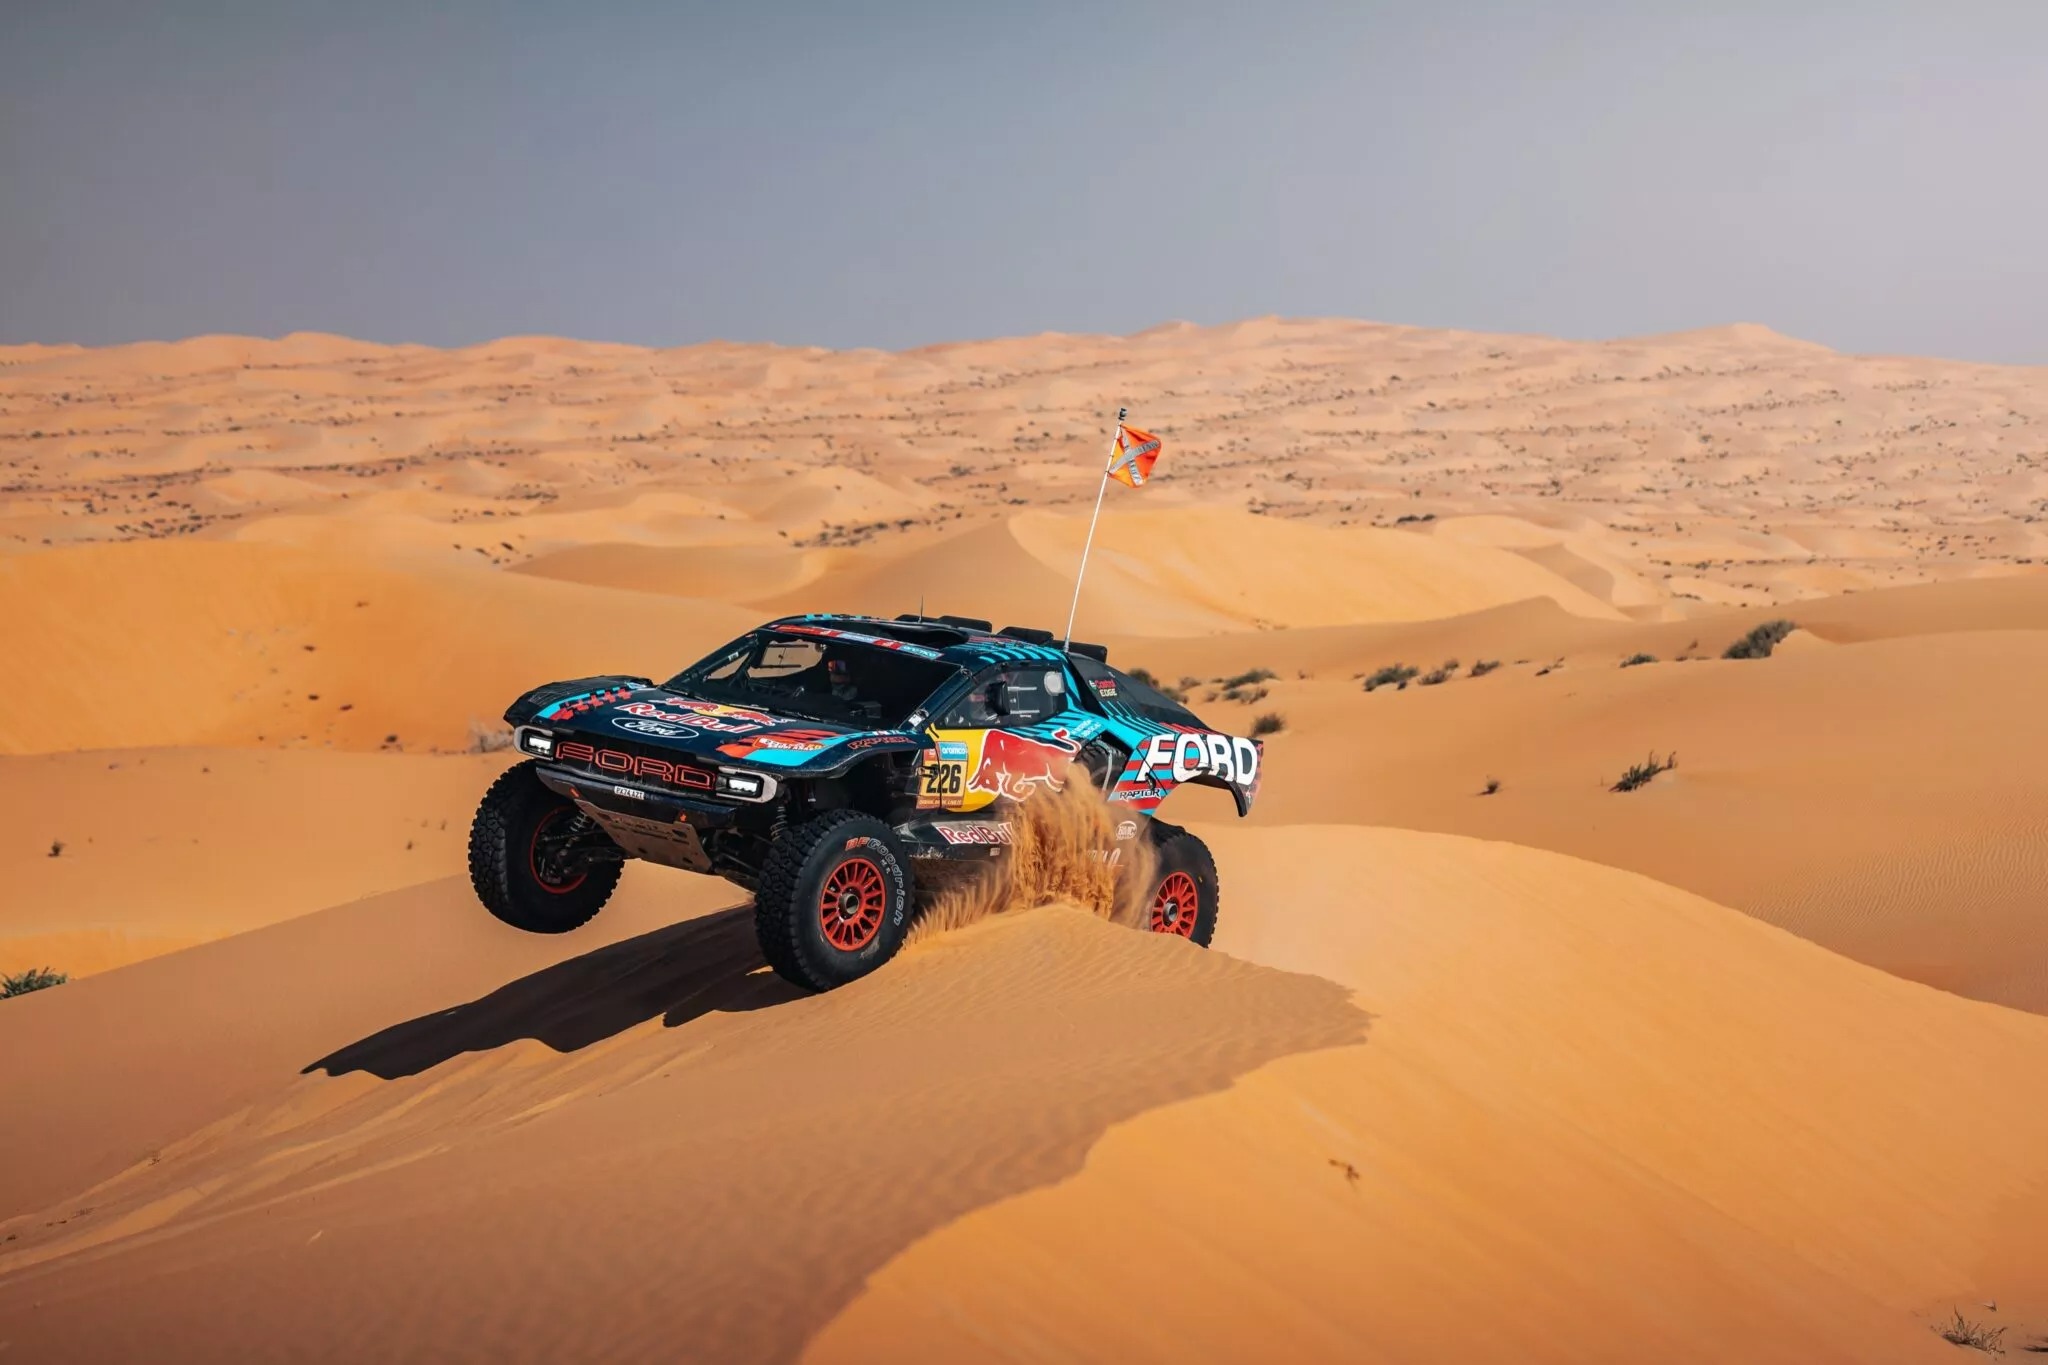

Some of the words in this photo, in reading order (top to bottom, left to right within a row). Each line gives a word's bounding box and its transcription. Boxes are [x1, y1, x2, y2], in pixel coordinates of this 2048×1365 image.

[1099, 688, 1118, 698] EDGE
[613, 702, 690, 722] Red
[676, 714, 763, 733] Bull
[624, 719, 686, 736] Ford
[942, 747, 966, 755] aramco
[1136, 733, 1258, 785] FORD
[556, 741, 716, 789] FORD
[926, 763, 962, 794] 226
[1119, 788, 1162, 803] RAPTOR
[936, 824, 988, 845] Red
[844, 836, 905, 926] BFGoodrich
